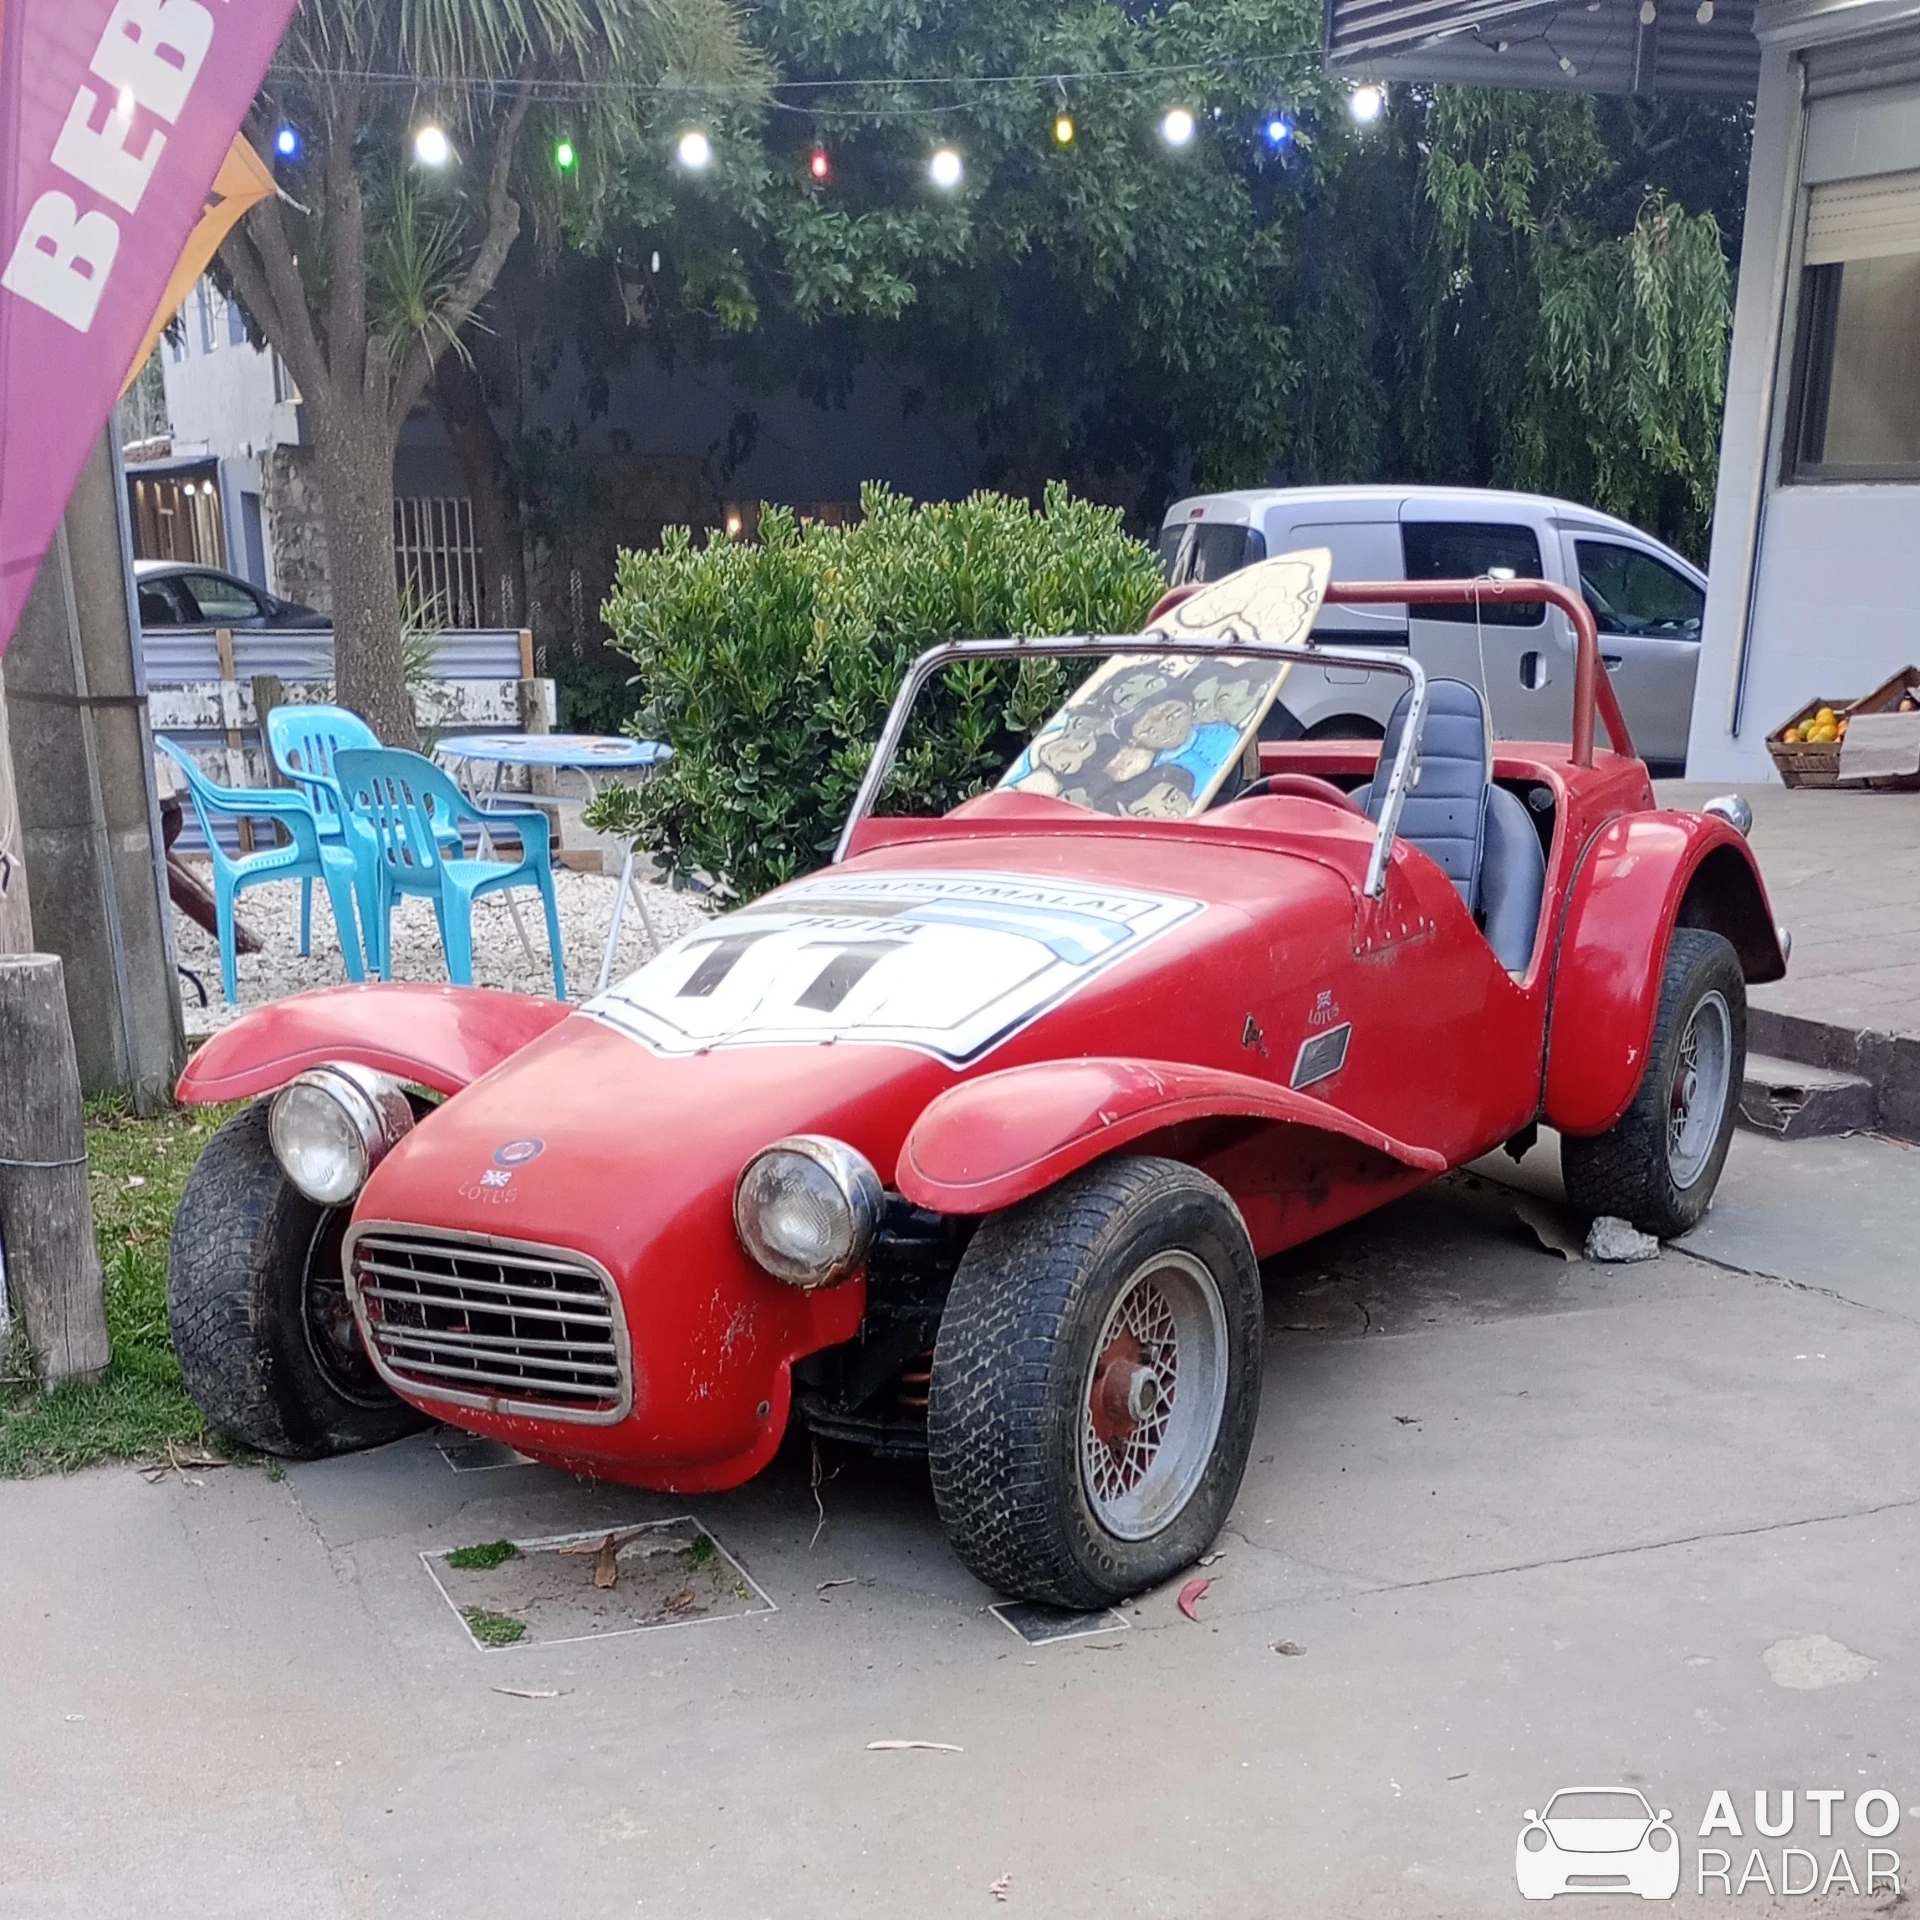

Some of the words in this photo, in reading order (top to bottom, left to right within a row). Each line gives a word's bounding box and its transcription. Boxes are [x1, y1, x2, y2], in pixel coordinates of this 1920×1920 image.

[1, 0, 230, 333] BEB
[787, 917, 926, 936] RUTA
[1308, 1003, 1340, 1025] LOTUS
[457, 1180, 518, 1203] LOTUS
